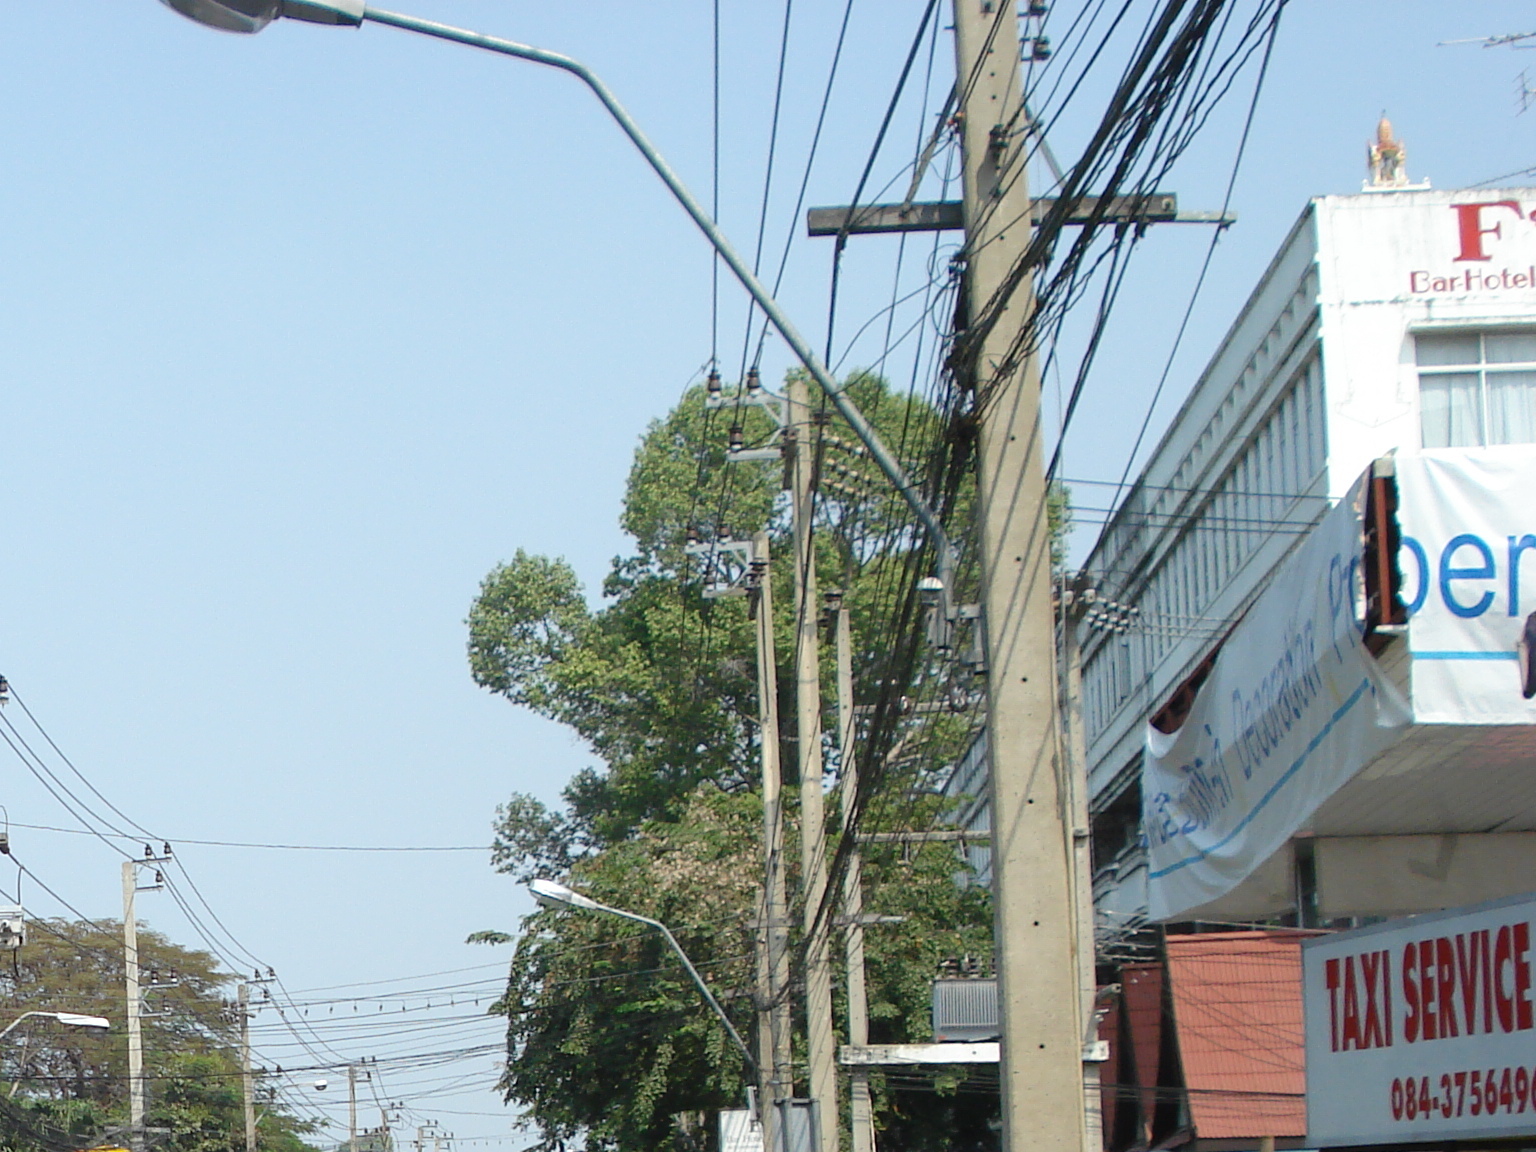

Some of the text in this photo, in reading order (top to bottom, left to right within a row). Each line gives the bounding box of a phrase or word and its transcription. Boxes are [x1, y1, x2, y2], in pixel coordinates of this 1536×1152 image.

[1449, 199, 1536, 262] F
[1326, 921, 1534, 1052] TAXI SERVICE
